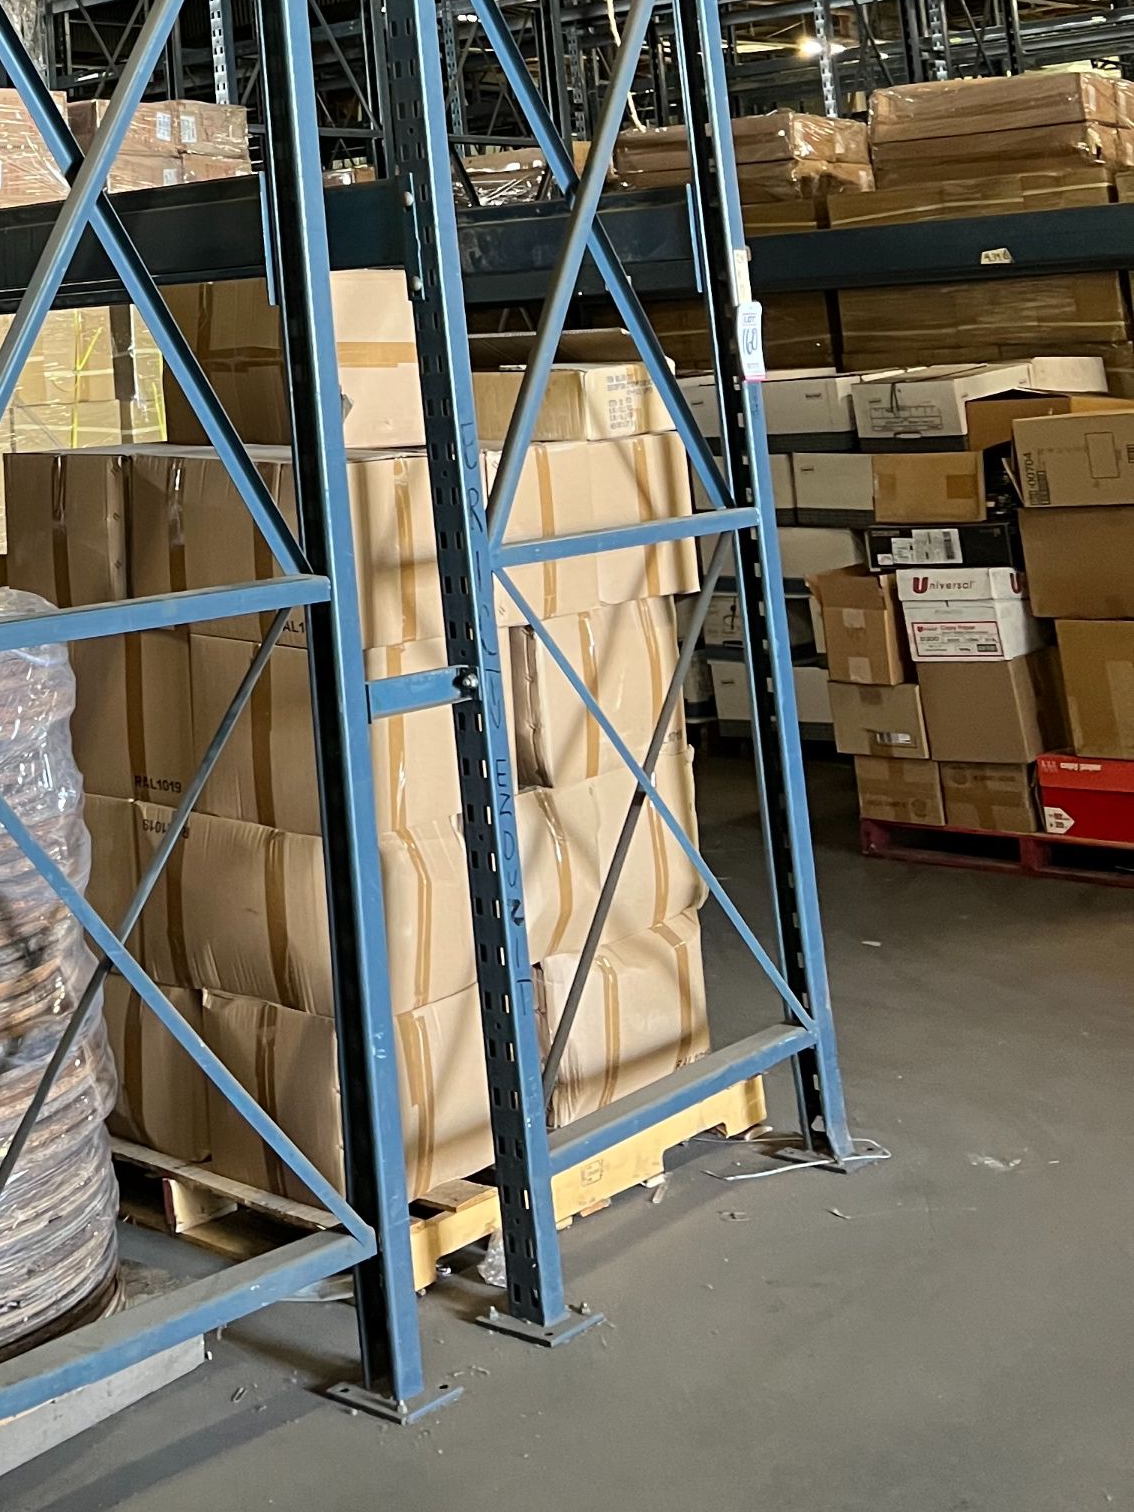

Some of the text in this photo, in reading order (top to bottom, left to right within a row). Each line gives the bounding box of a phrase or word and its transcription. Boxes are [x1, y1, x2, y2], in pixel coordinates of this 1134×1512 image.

[742, 327, 758, 355] 160
[912, 576, 973, 594] Universal
[134, 775, 182, 793] RAL1019
